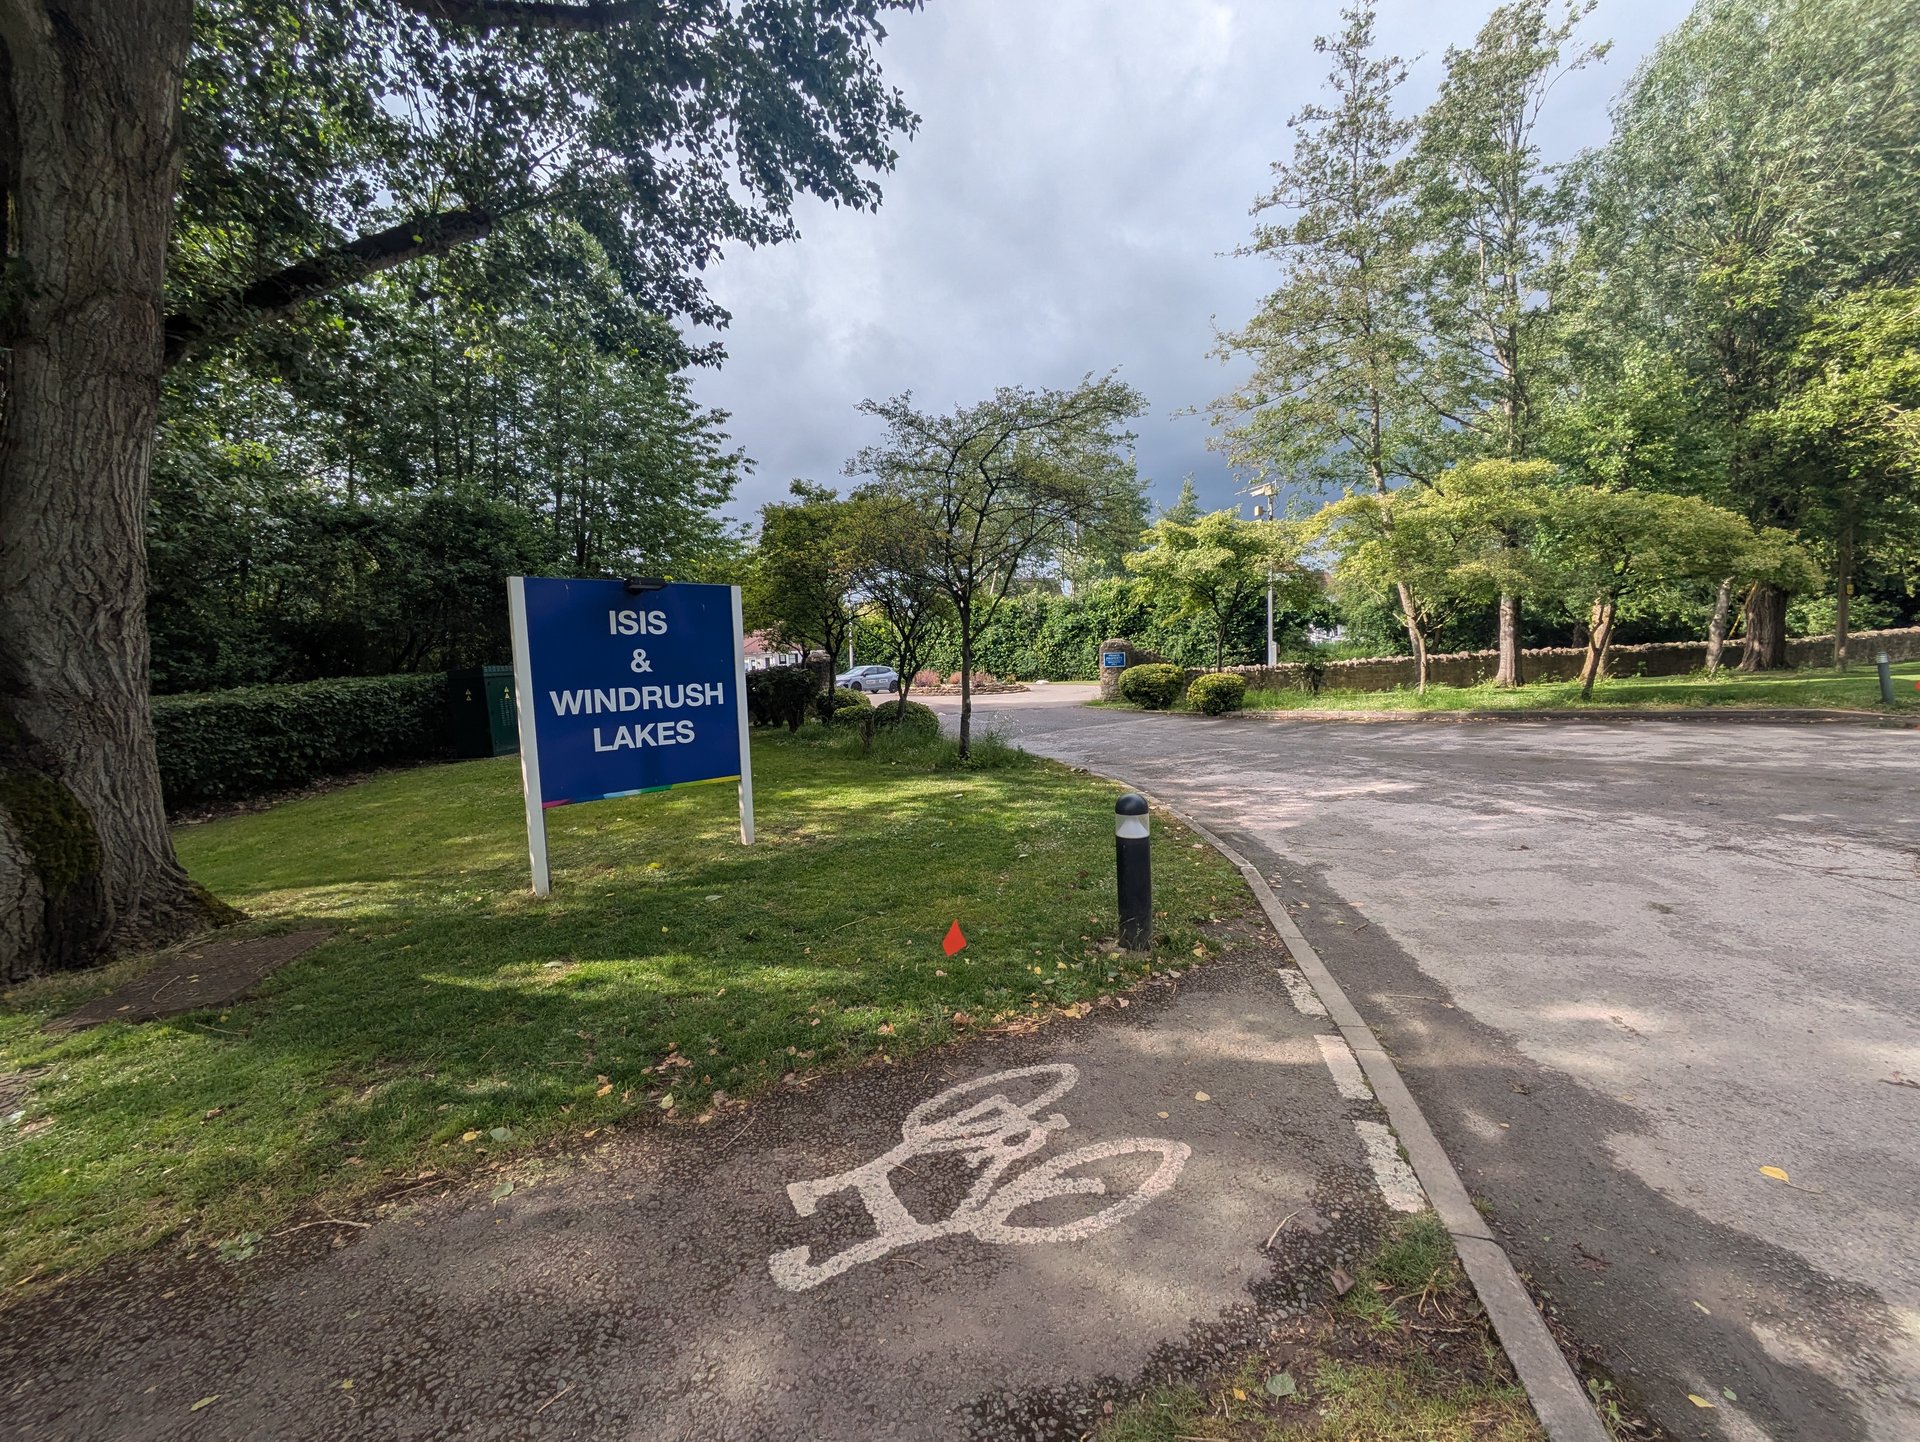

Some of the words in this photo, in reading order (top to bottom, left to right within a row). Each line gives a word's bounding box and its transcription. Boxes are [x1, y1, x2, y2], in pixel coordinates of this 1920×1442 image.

[609, 610, 667, 635] ISIS
[631, 649, 653, 673] &
[549, 682, 724, 716] WINDRUSH
[593, 719, 695, 753] LAKES
